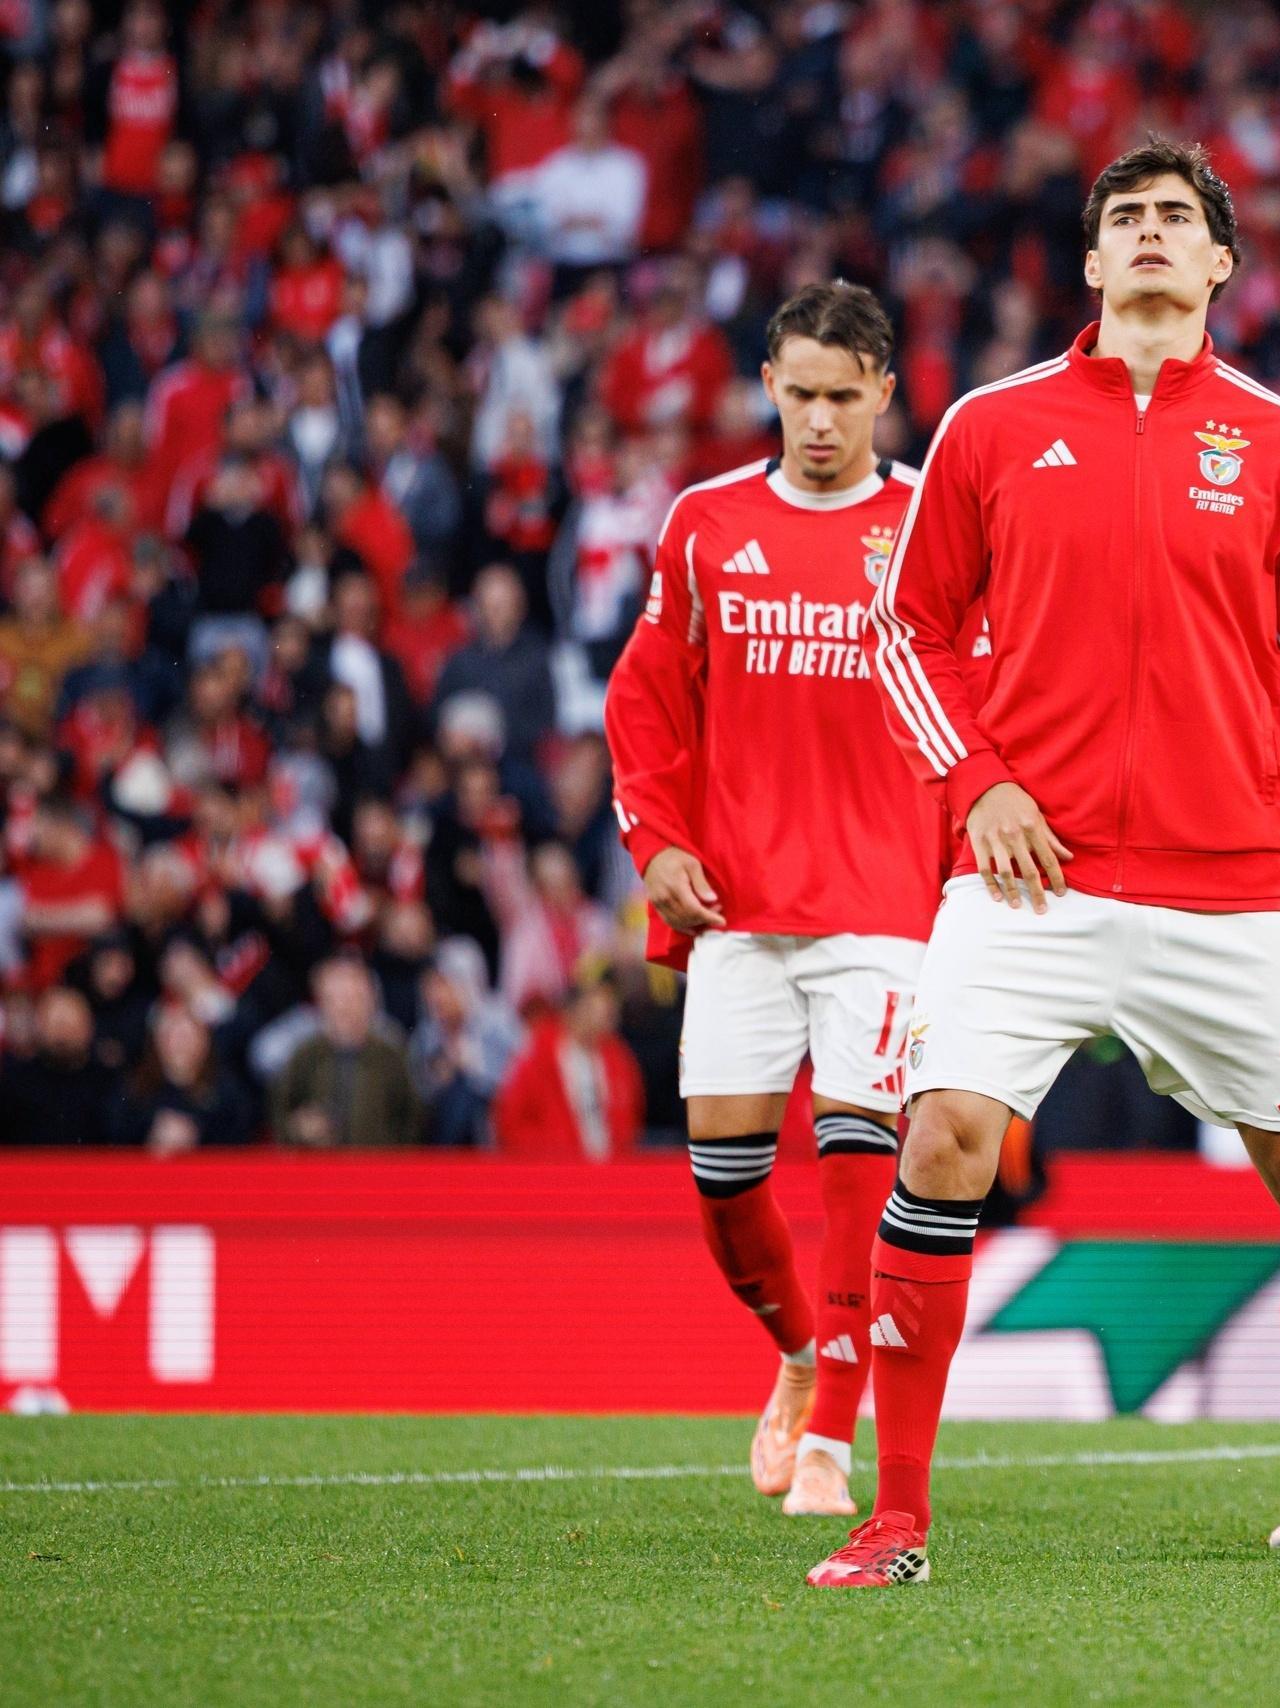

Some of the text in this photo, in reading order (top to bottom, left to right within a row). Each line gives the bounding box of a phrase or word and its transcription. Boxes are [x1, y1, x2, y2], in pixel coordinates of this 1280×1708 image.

[1188, 486, 1244, 506] Emirates
[1196, 499, 1235, 515] FLY BETTER
[717, 592, 869, 640] Emirat
[746, 638, 783, 674] FLY
